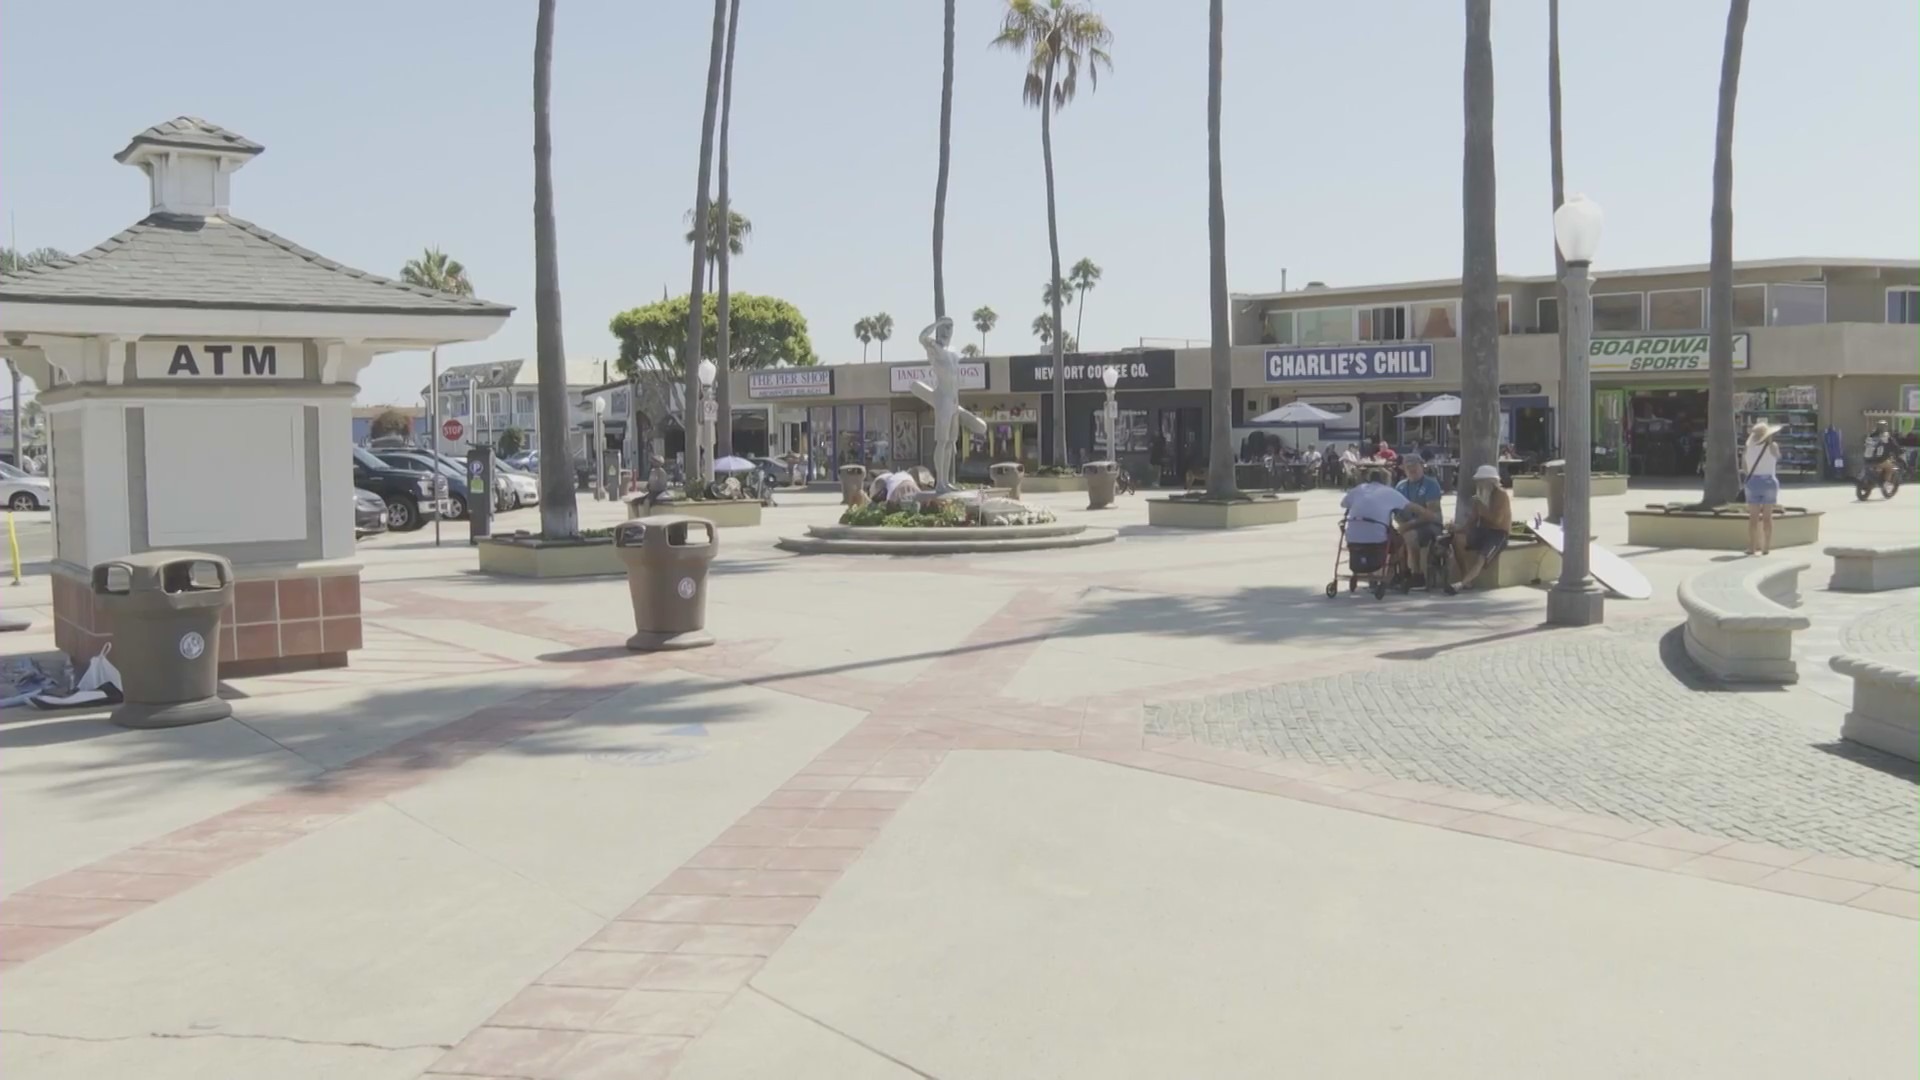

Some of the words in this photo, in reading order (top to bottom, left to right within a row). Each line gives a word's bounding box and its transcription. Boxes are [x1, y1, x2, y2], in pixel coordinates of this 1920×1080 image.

[1589, 336, 1743, 356] BOARDWAK
[167, 344, 277, 376] ATM
[1269, 352, 1368, 377] CHARLIE'S
[1373, 350, 1428, 374] CHILI
[1629, 355, 1700, 370] SPORTS
[752, 374, 773, 387] THE
[776, 373, 798, 386] PIER
[801, 371, 829, 384] SHOP
[1034, 365, 1085, 380] NEWORT
[1131, 362, 1149, 378] CO.
[443, 424, 463, 437] STOP
